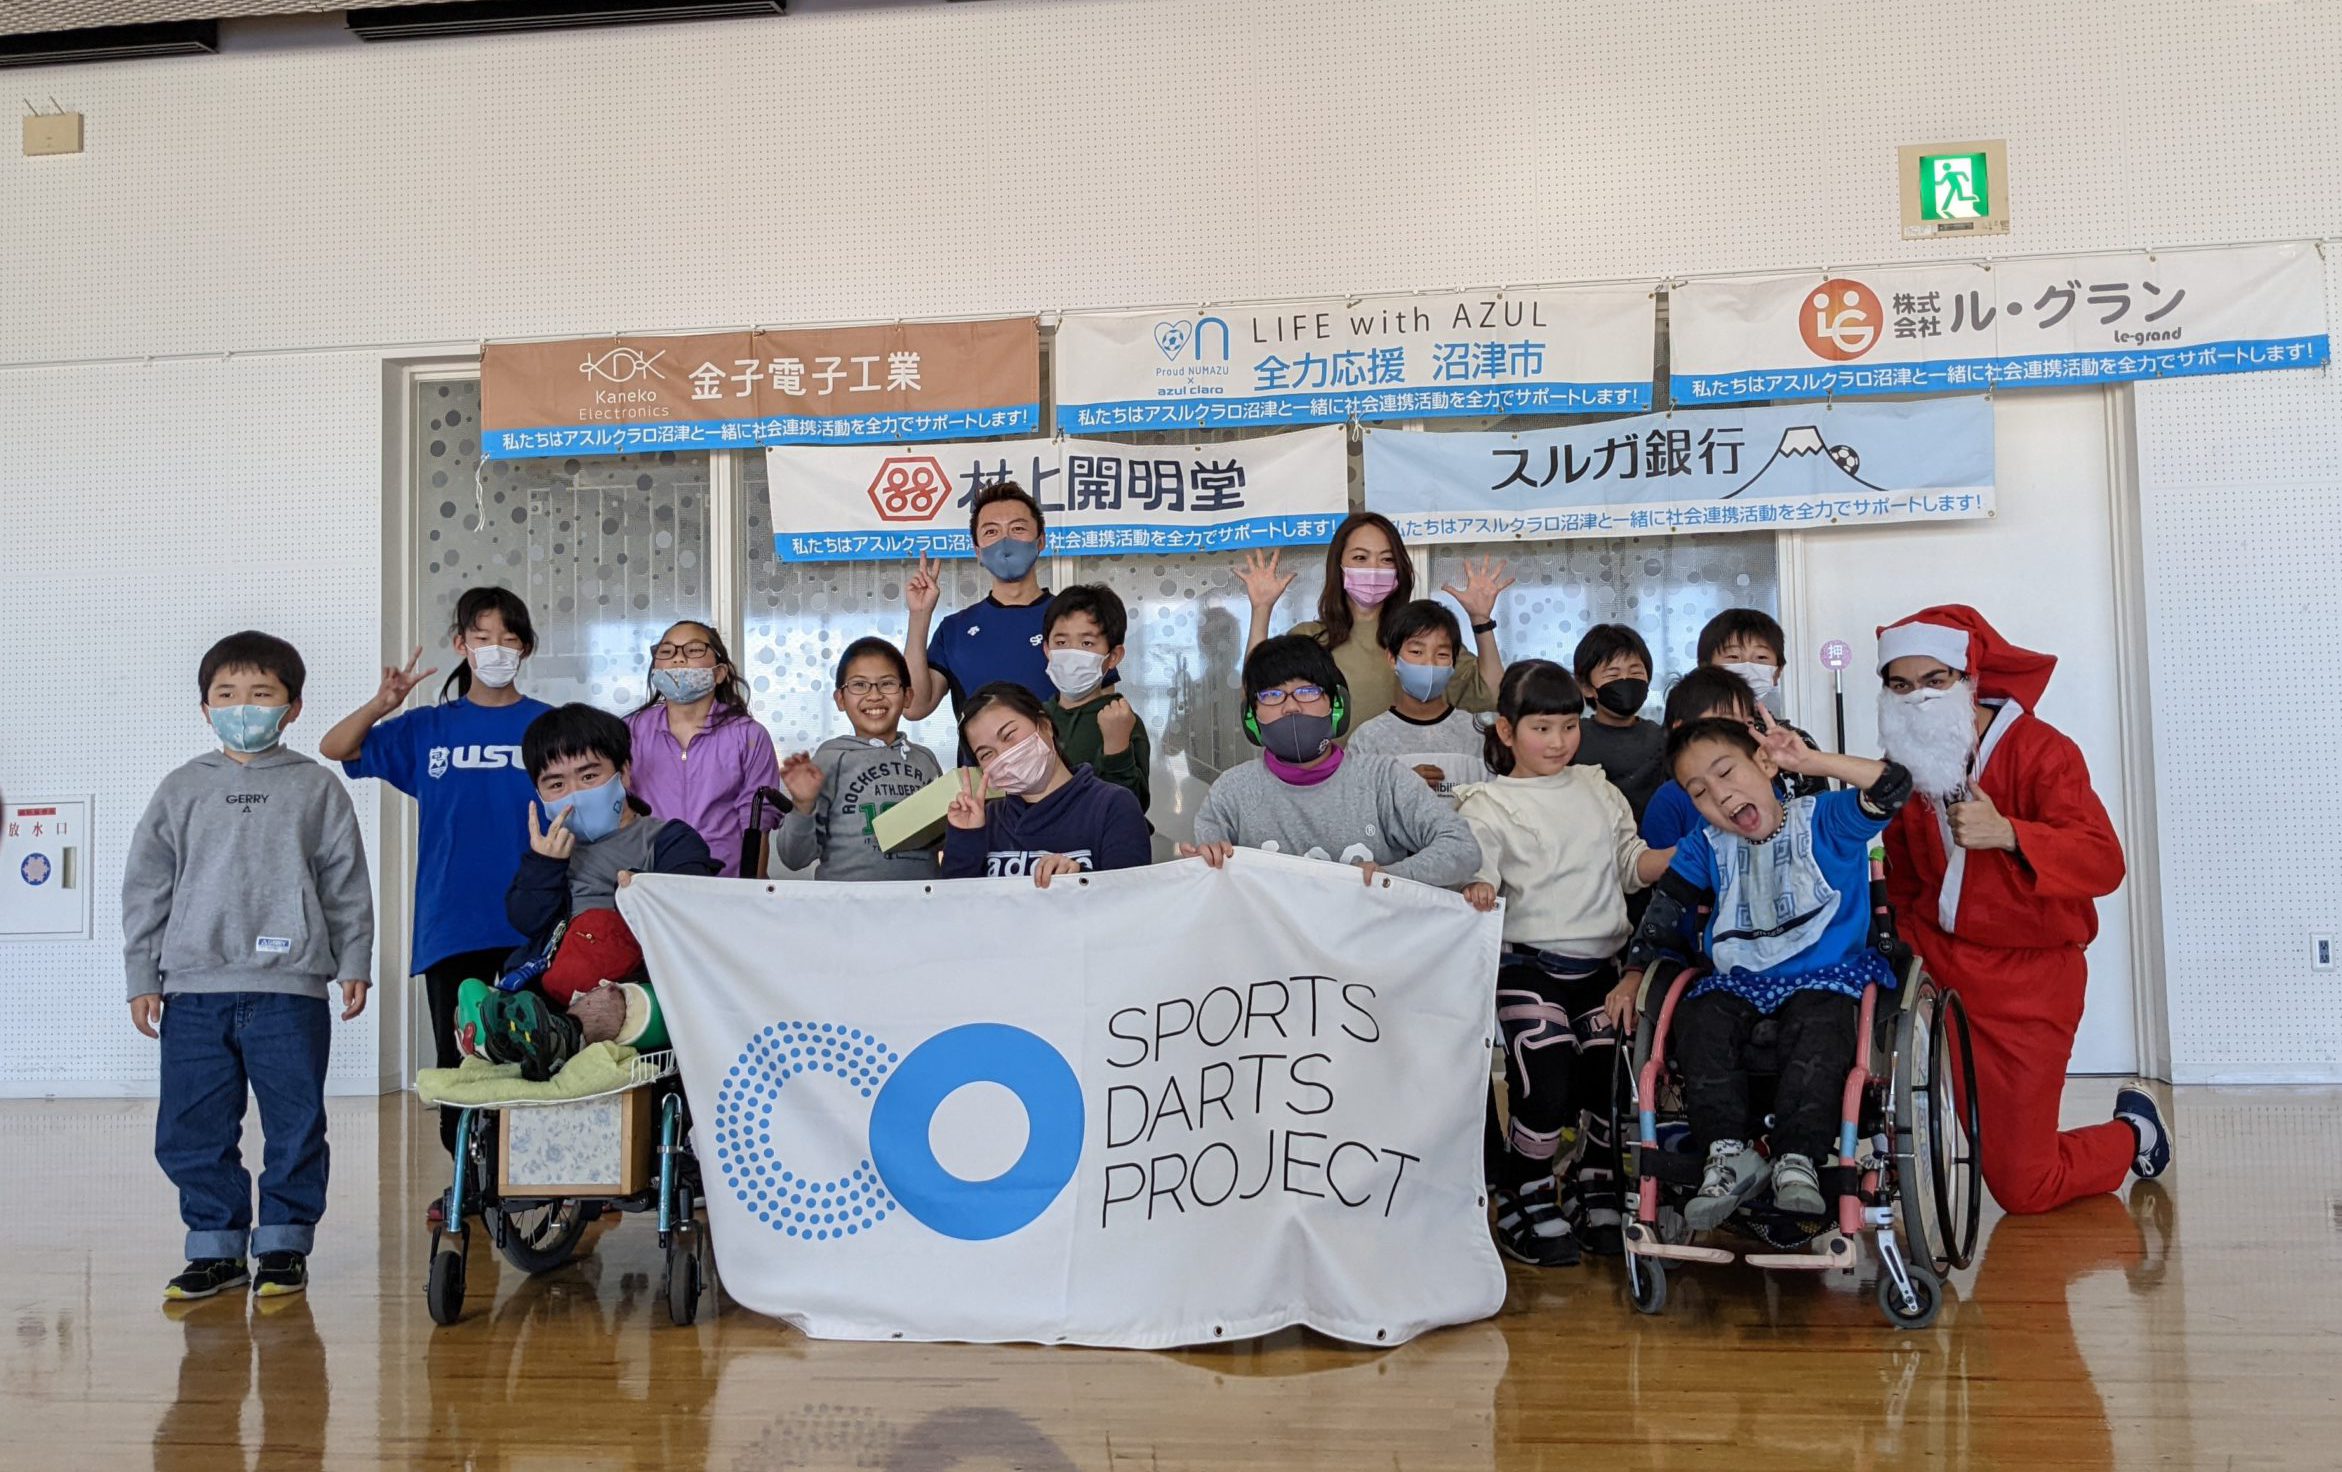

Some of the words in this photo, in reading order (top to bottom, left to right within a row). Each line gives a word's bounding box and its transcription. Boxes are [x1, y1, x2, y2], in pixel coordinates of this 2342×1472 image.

[1252, 313, 1330, 343] LIFE
[1350, 306, 1430, 335] with
[1452, 301, 1547, 329] AZUL
[1892, 291, 1941, 315] 株式
[1950, 280, 2186, 332] ル・グラン
[1893, 316, 1941, 339] 会社
[688, 351, 922, 400] 金子電子工業
[1156, 367, 1185, 377] Proud
[1188, 365, 1229, 376] NUMAZU
[1253, 346, 1406, 391] 全力応援
[1431, 339, 1547, 381] 沼津市
[1692, 342, 2313, 398] 私たちはアスルクラロ沼津と一緒に社会連携活動を全力でサポートします!
[595, 388, 657, 404] Kaneko
[1077, 388, 1638, 427] 私たちはアスルクラロ沼津と一緒に社会連携活動を全力でサポートします!
[1157, 386, 1187, 396] azul
[1189, 385, 1224, 395] claro
[502, 409, 1028, 450] 私たちはアスルクラロ沼津と一緒に社会連携活動を全力でサポートします!
[579, 407, 670, 421] Electronics
[1490, 428, 1745, 491] スルガ銀行
[225, 794, 270, 804] GERRY
[8, 821, 68, 838] 放水口
[1106, 975, 1380, 1068] SPORTS
[1107, 1054, 1334, 1149] DARTS
[1101, 1130, 1421, 1228] PROJECT
